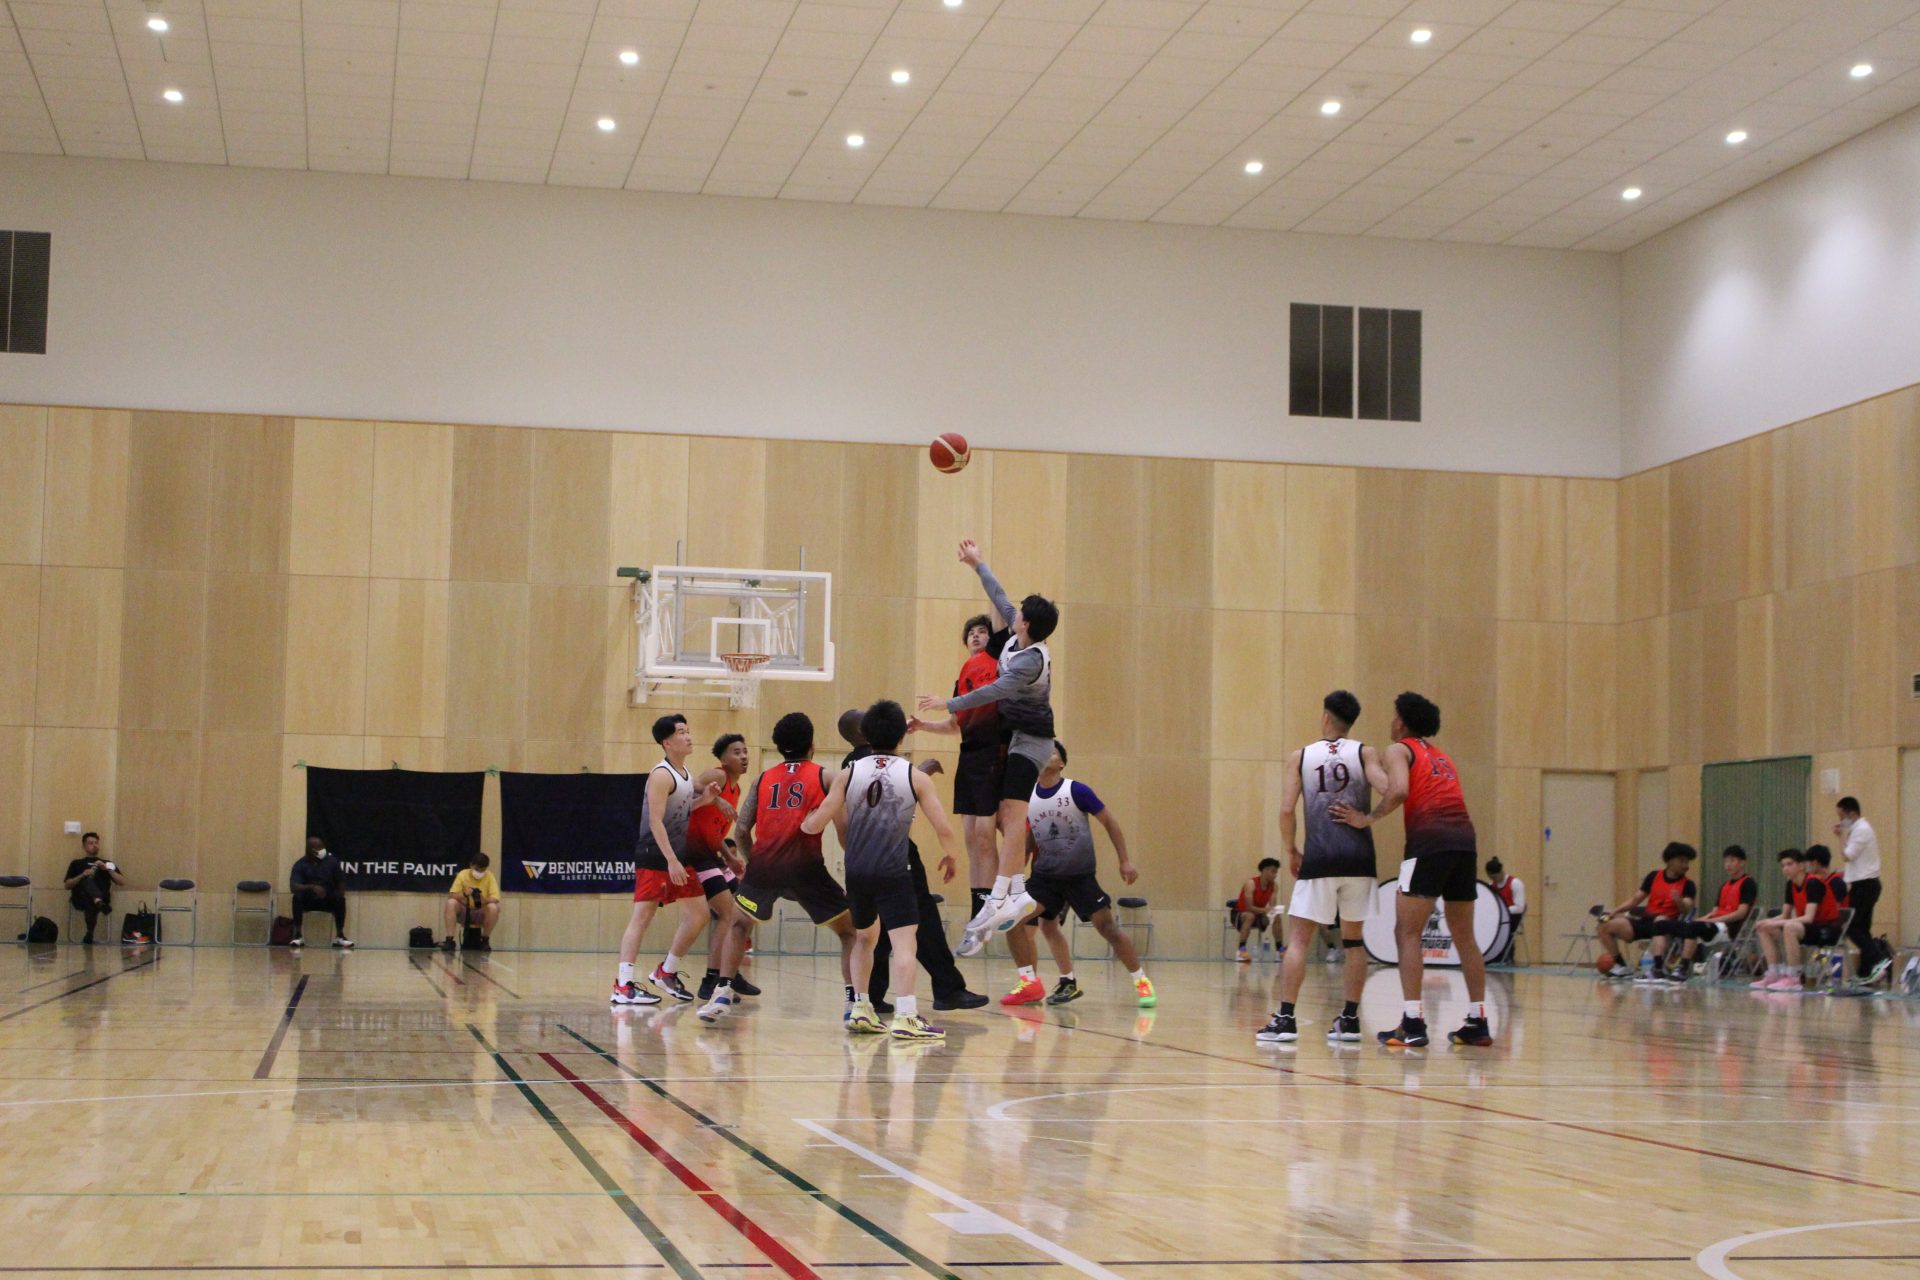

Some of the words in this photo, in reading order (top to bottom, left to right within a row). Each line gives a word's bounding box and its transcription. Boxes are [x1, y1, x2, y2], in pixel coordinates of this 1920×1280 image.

[1314, 763, 1350, 793] 19
[767, 782, 804, 809] 18
[867, 779, 883, 808] 0
[1056, 796, 1070, 808] 33
[363, 861, 399, 874] THE
[403, 862, 457, 876] PAINT
[548, 861, 592, 874] BENCH
